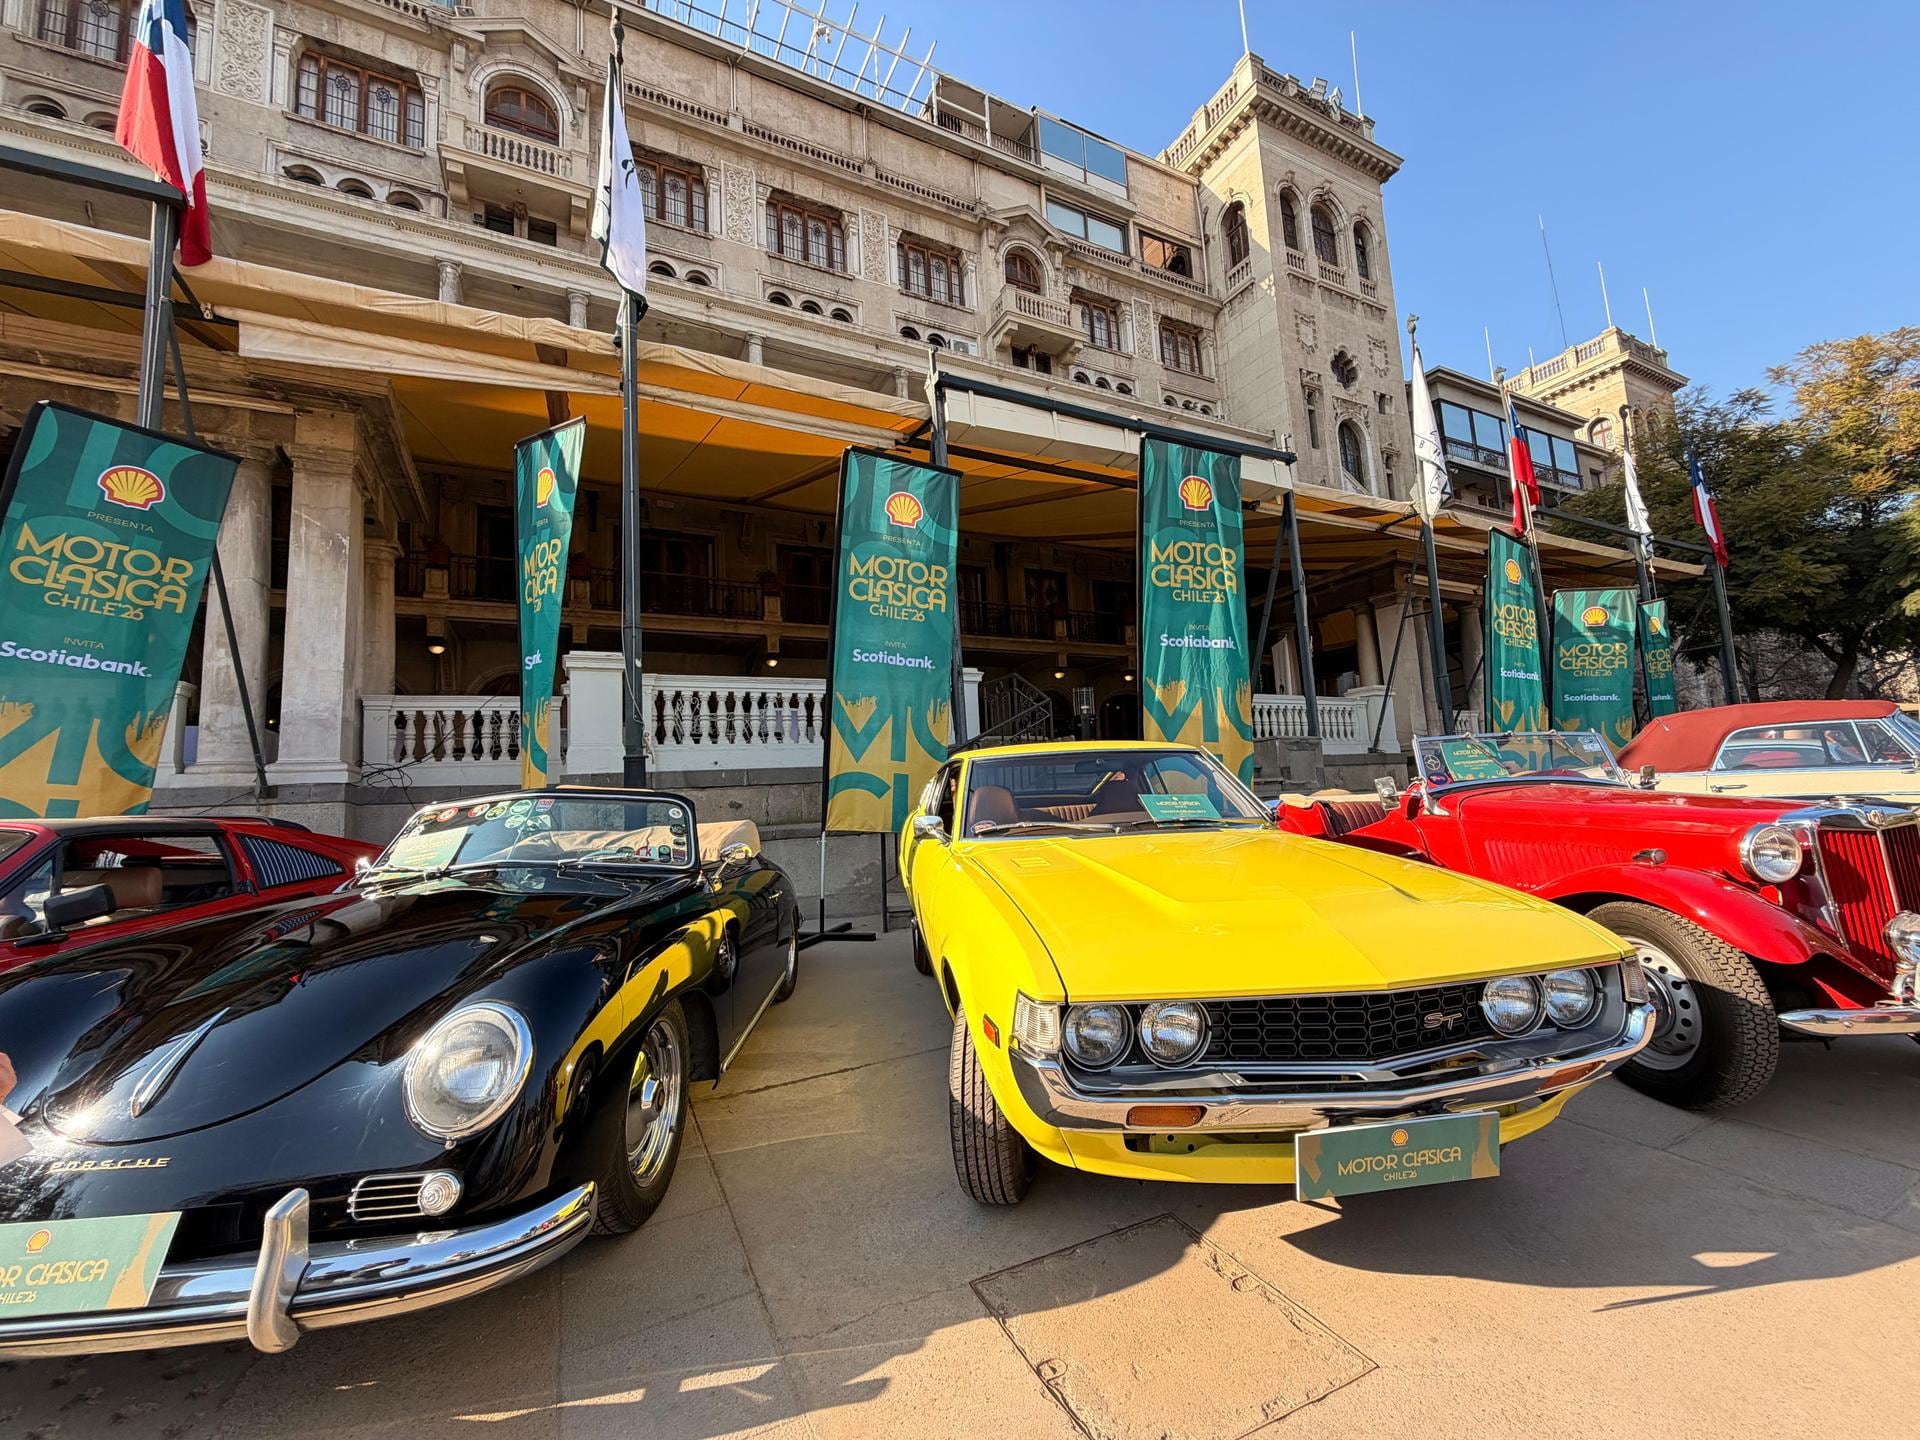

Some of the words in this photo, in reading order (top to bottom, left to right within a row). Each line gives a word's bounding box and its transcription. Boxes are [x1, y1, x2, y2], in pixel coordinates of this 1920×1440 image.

[87, 511, 154, 533] PRESENTA
[1179, 519, 1216, 529] PRESENTA
[882, 533, 921, 547] PRESENTA
[16, 522, 193, 587] MOTOR
[1151, 539, 1237, 571] MOTOR
[849, 551, 948, 590] MOTOR
[1151, 564, 1237, 594] CLASICA
[9, 555, 188, 614] CLASICA
[849, 578, 946, 613] CLASICA
[1493, 599, 1536, 626] MOTOR
[64, 636, 105, 650] INVITA
[1494, 618, 1537, 643] CLASICA
[1559, 642, 1628, 657] MOTOR
[1559, 655, 1628, 670] CLASICA
[1423, 1012, 1463, 1031] ST
[50, 1157, 172, 1172] PORSCHE
[1338, 1154, 1398, 1176] MOTOR
[1402, 1146, 1462, 1168] CLASICA
[25, 1258, 109, 1287] CLASICA
